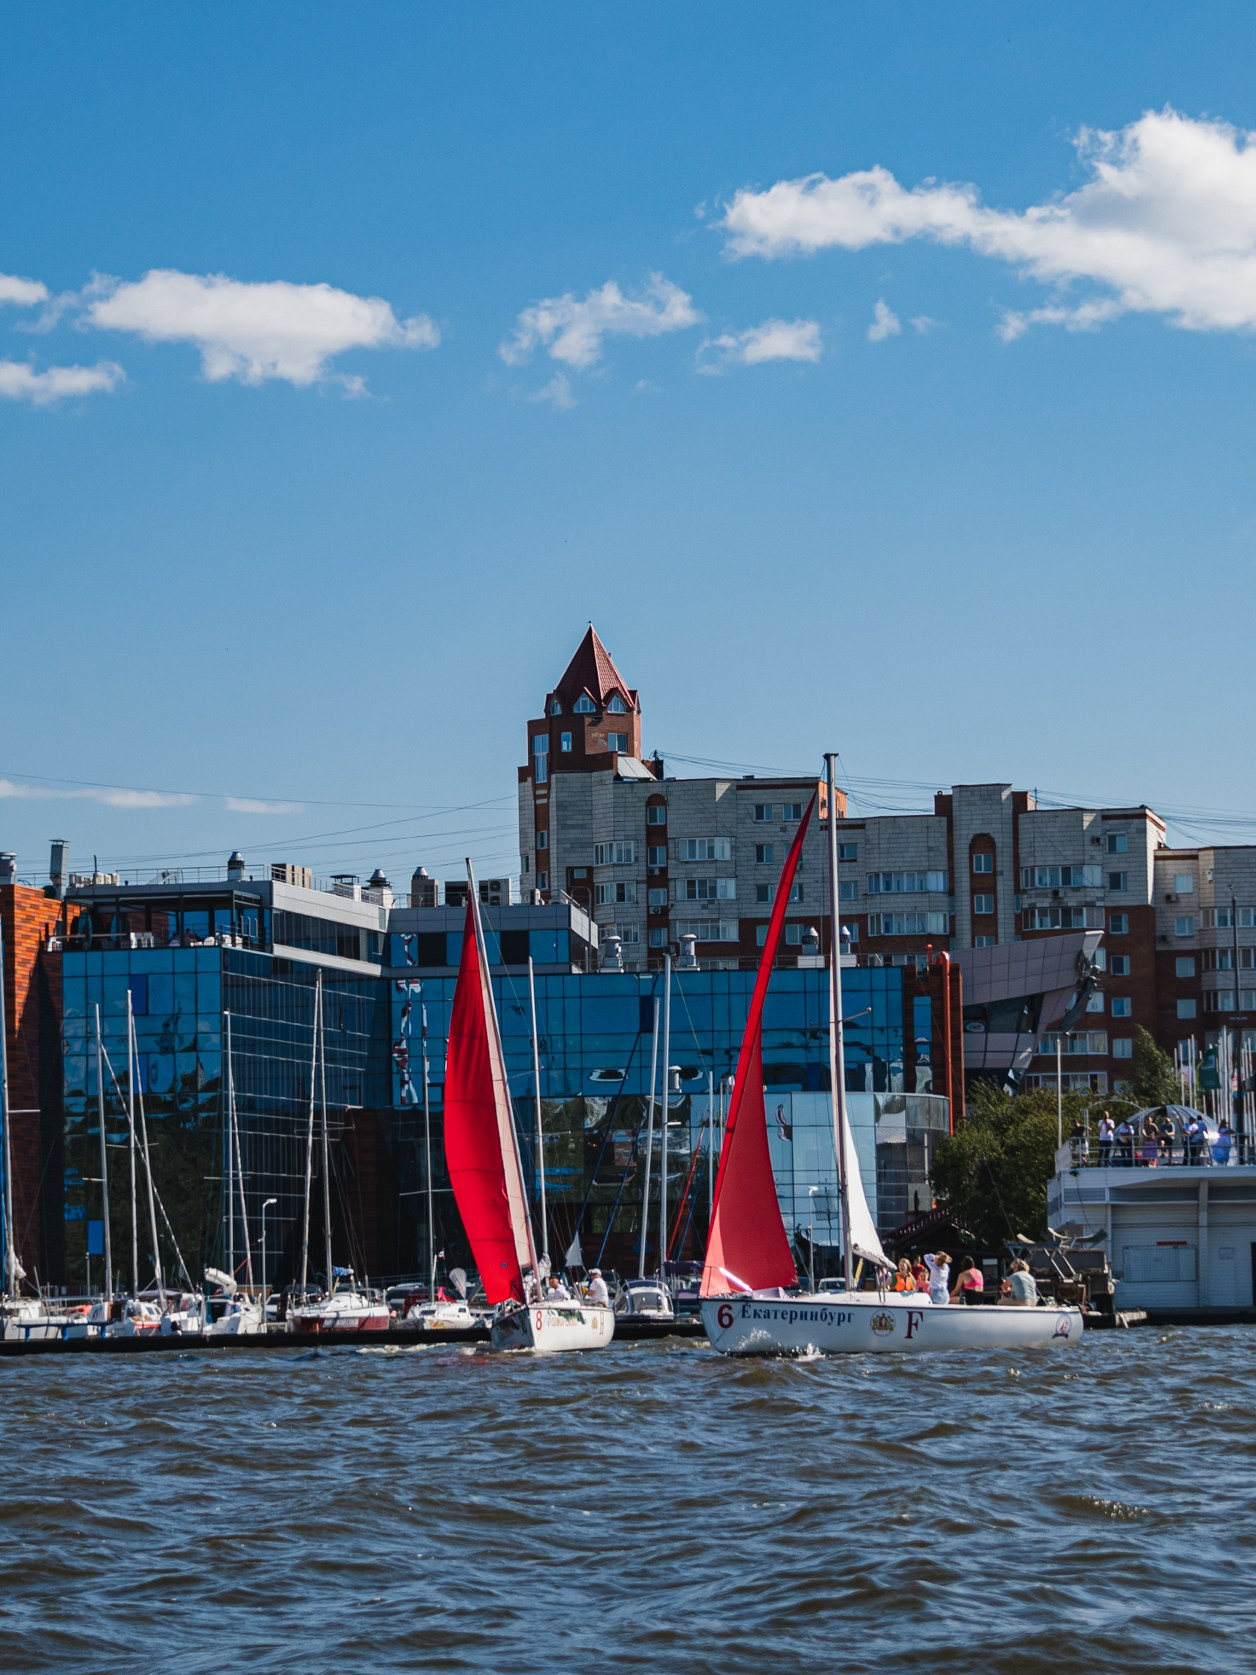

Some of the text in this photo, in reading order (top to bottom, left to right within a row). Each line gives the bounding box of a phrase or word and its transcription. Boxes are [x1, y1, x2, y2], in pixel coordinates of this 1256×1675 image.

[536, 1310, 543, 1331] 8
[717, 1303, 734, 1329] 6
[740, 1304, 855, 1326] Екатеринбург
[904, 1310, 924, 1339] F
